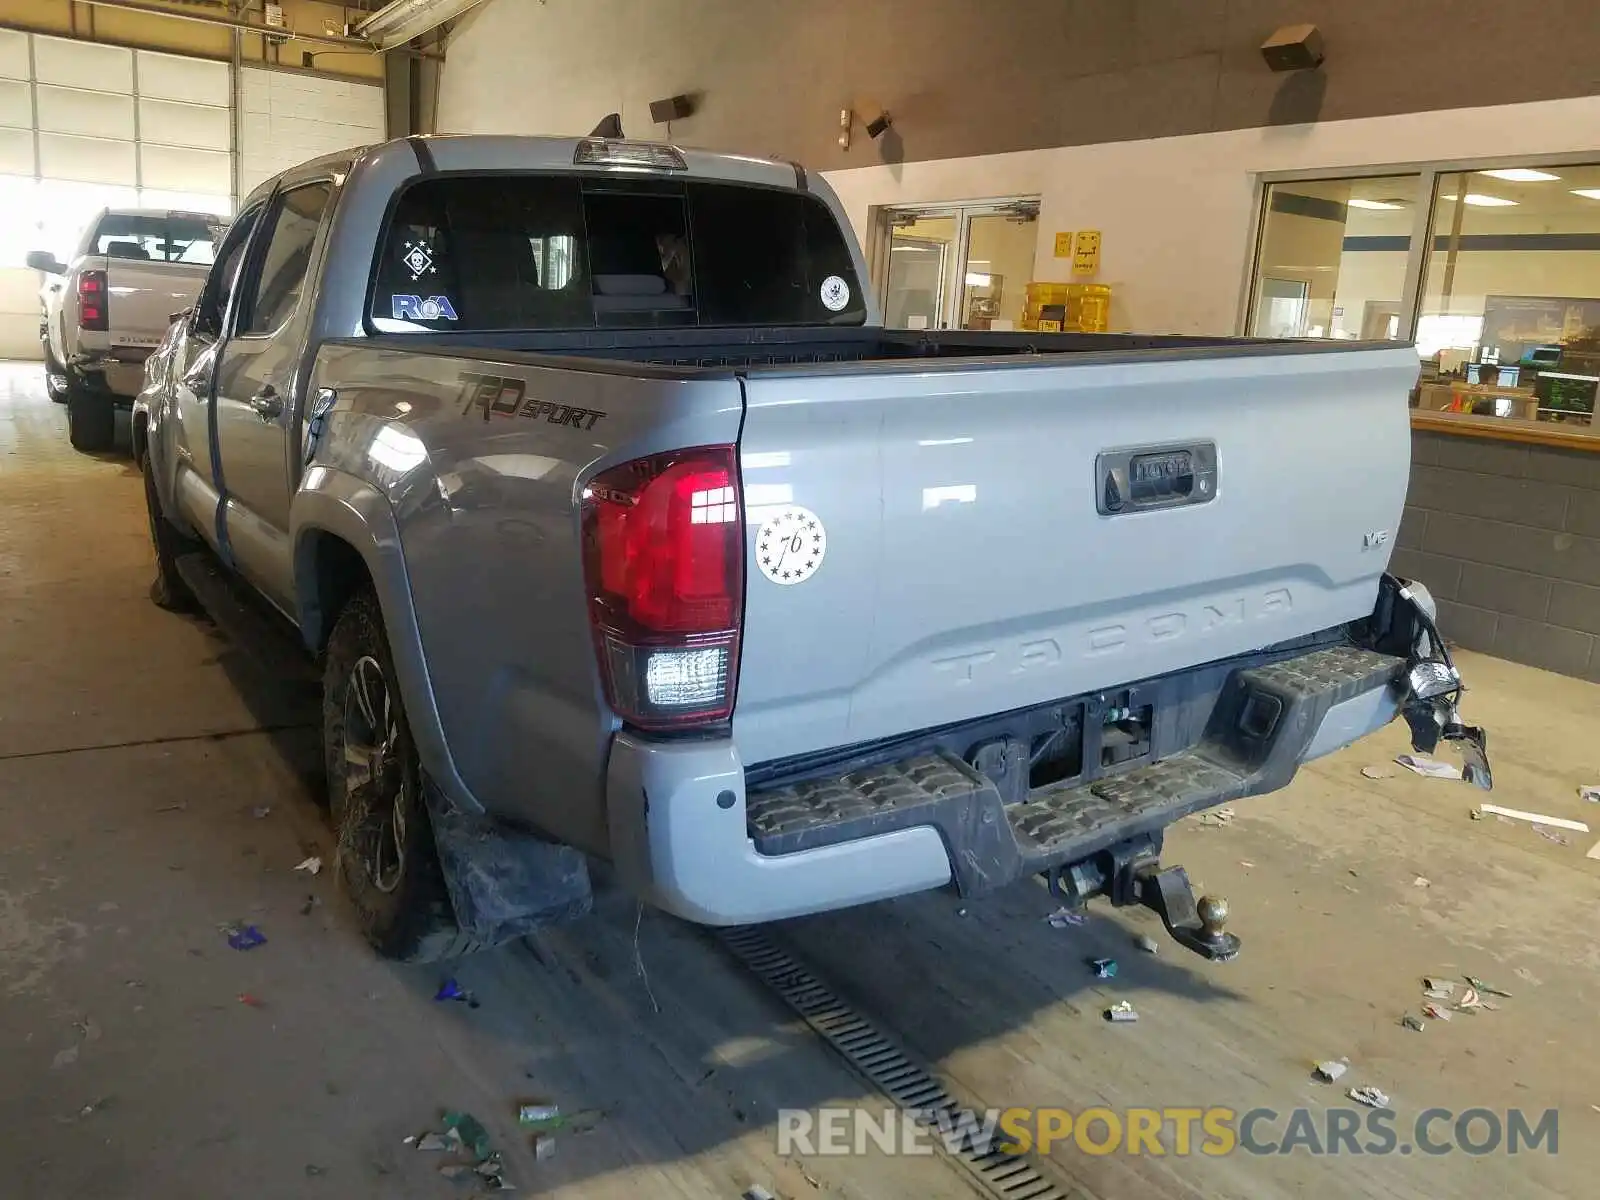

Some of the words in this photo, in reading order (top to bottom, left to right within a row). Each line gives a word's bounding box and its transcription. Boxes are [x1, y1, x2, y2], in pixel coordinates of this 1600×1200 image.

[455, 371, 526, 424] TRD
[518, 399, 608, 431] SPORT
[780, 526, 807, 568] 76
[931, 587, 1294, 686] TACOMA
